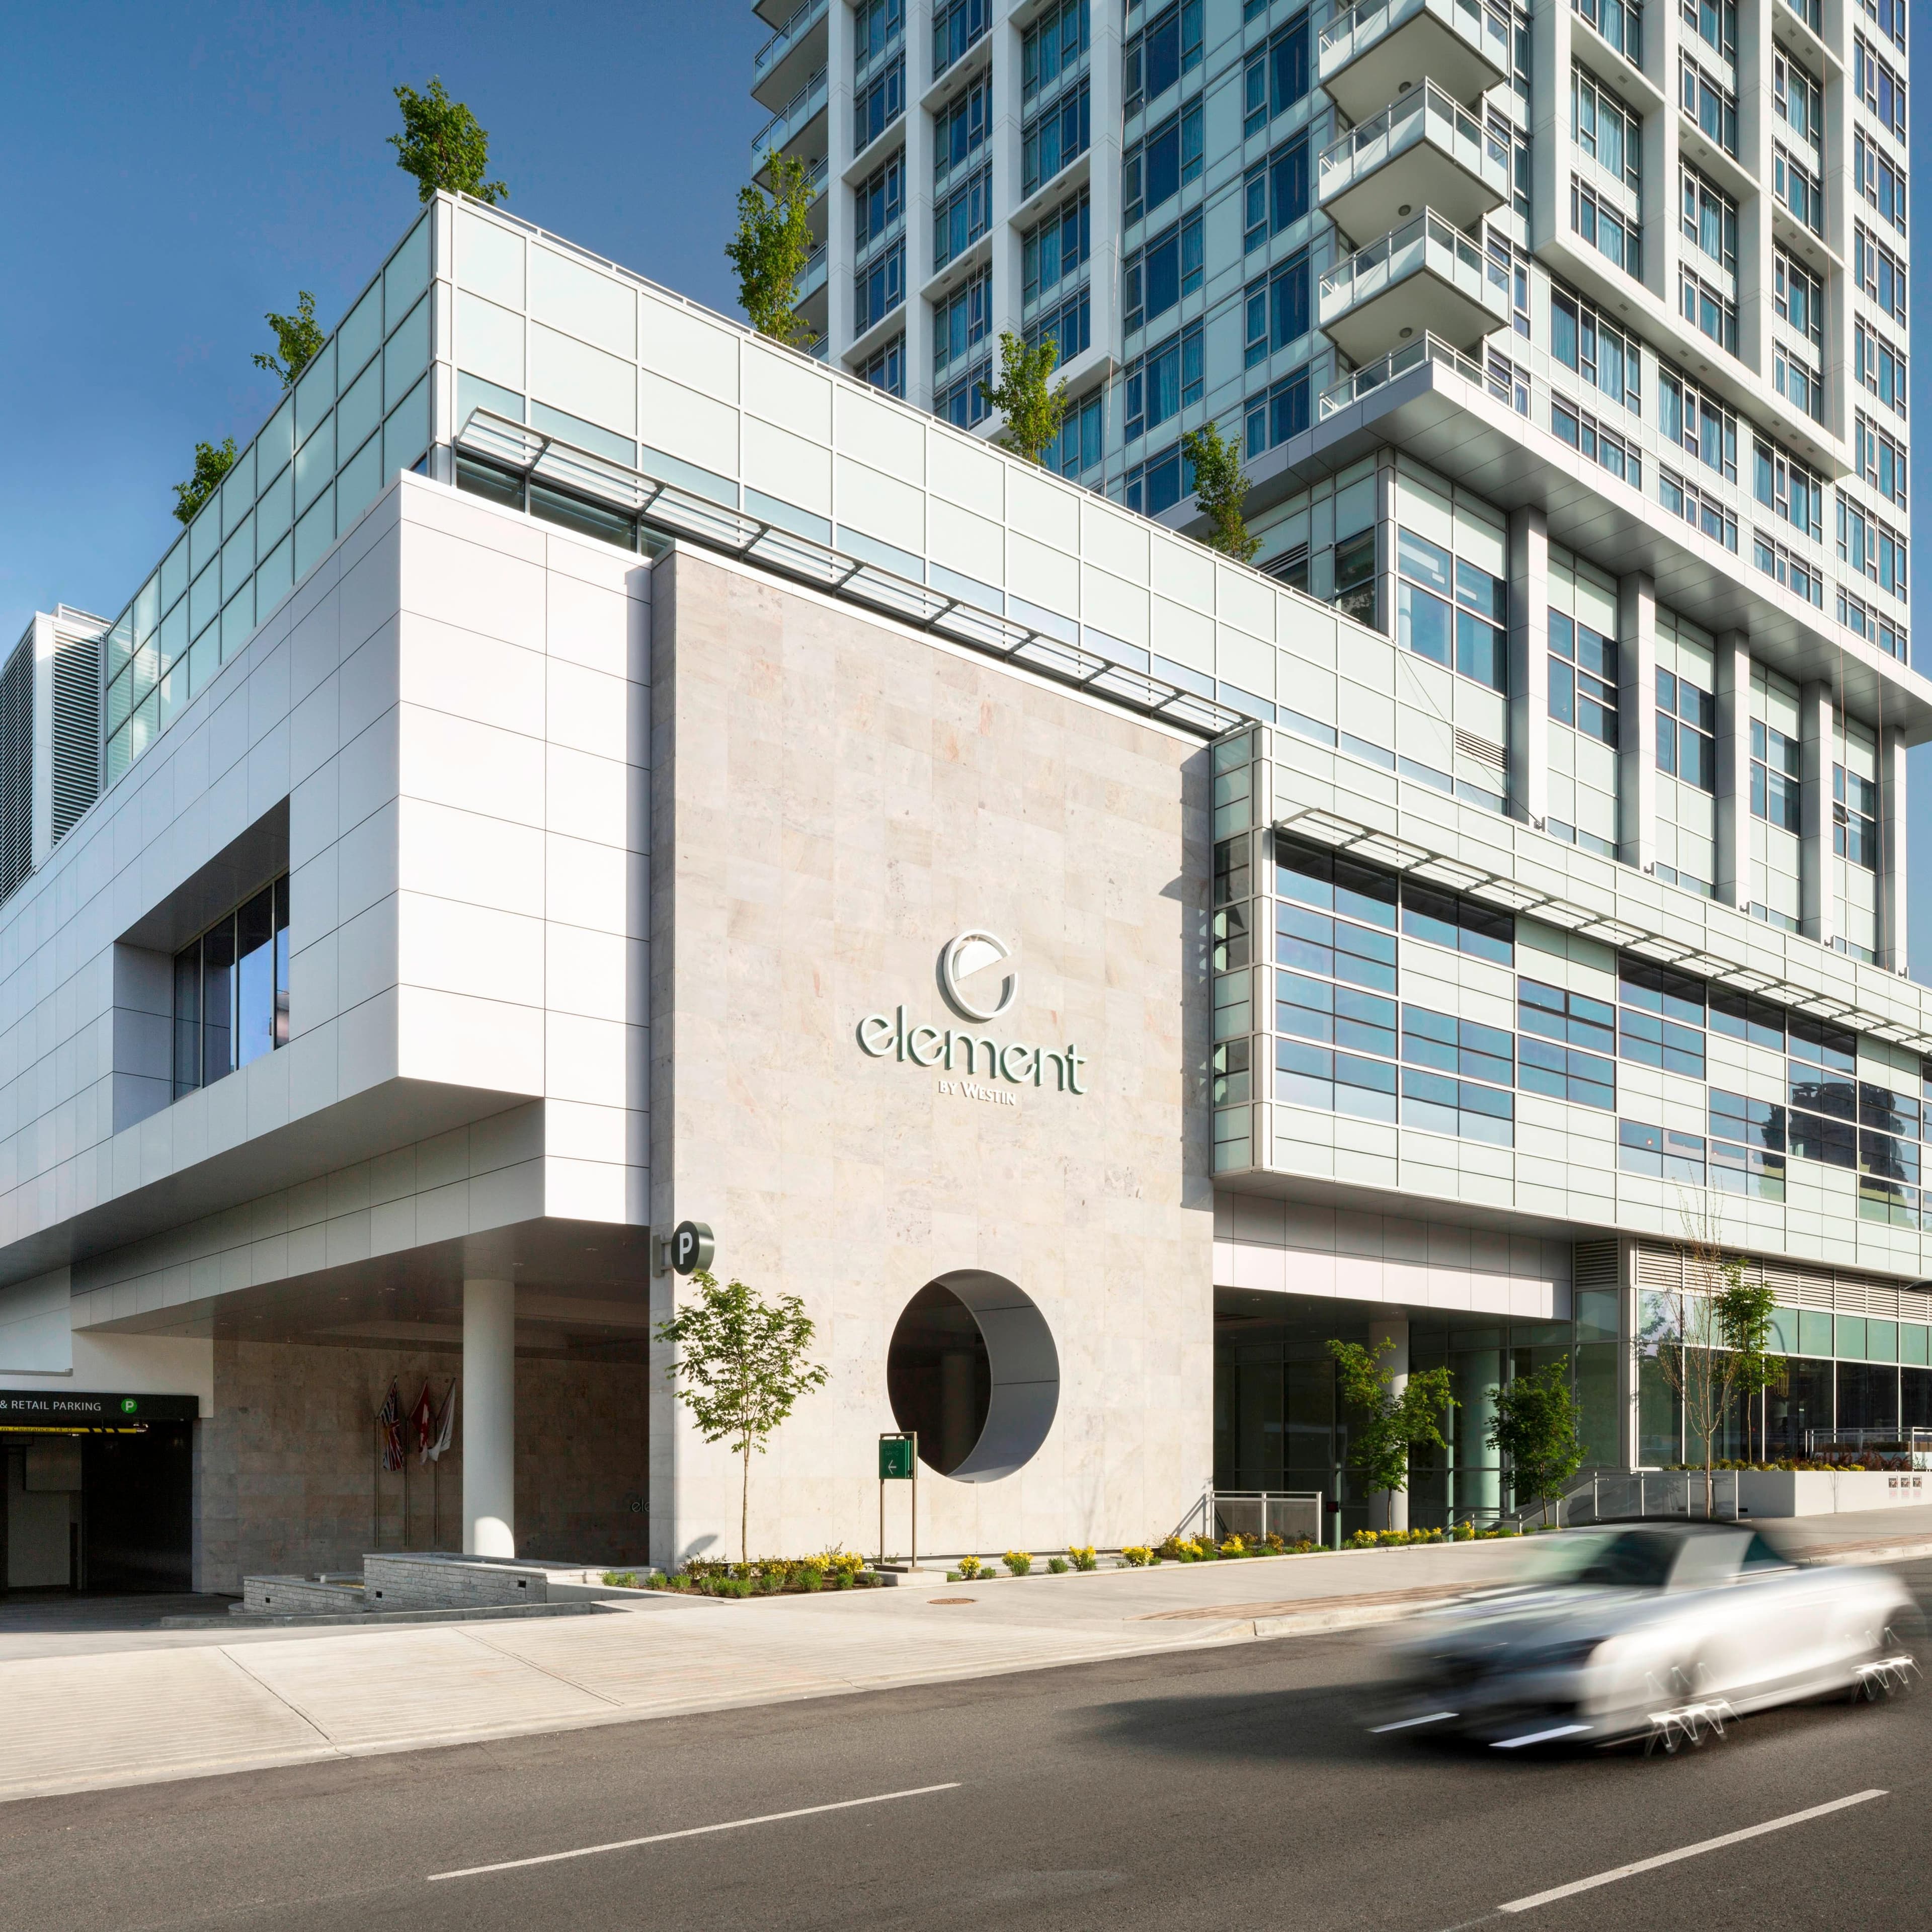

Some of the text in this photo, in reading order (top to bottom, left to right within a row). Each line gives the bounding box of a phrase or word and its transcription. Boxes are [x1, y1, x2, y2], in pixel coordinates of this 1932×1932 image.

[857, 1005, 1088, 1094] element
[939, 1081, 1015, 1105] BY WESTIN
[679, 1232, 693, 1265] P
[0, 1400, 101, 1411] & RETAIL PARKING
[125, 1401, 134, 1411] P
